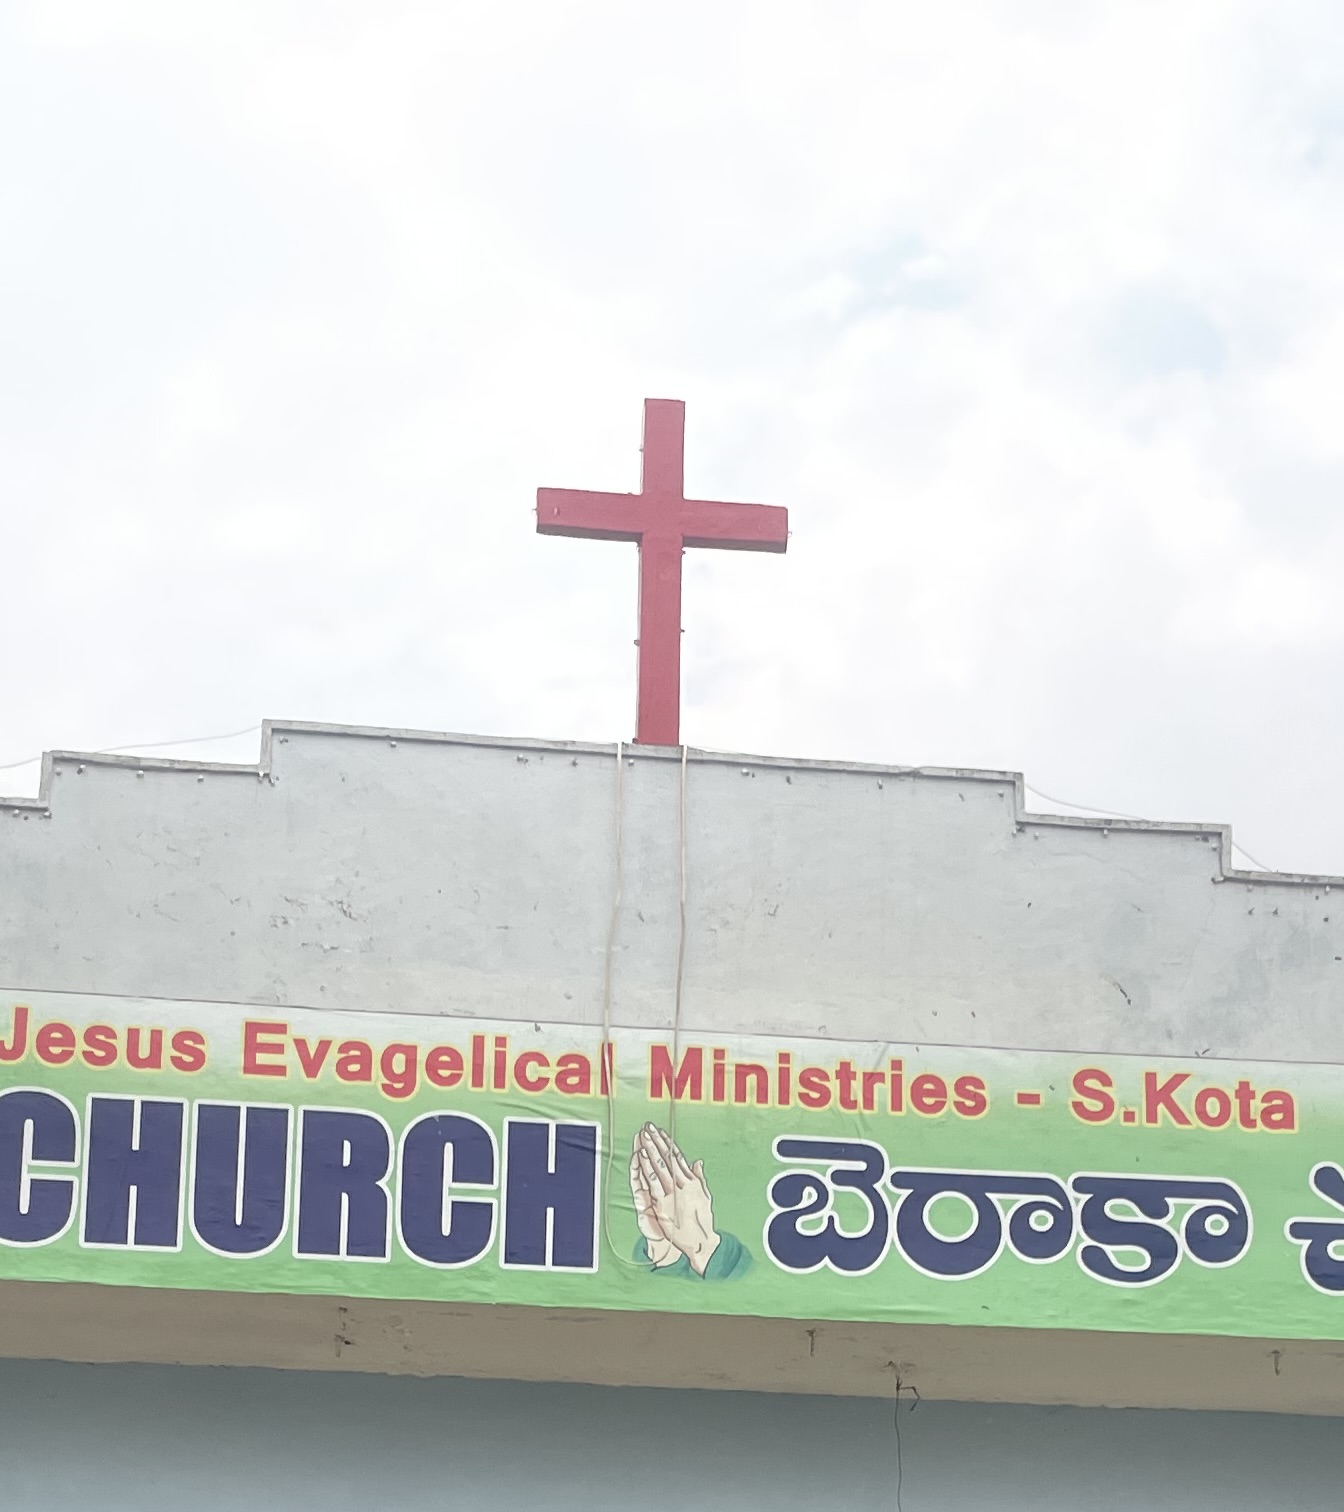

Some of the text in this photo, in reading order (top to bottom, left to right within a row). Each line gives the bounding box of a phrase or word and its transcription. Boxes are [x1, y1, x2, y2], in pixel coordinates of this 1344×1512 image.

[241, 1019, 615, 1100] Evagelical
[647, 1044, 989, 1118] Ministries
[1071, 1067, 1298, 1132] S.Kota
